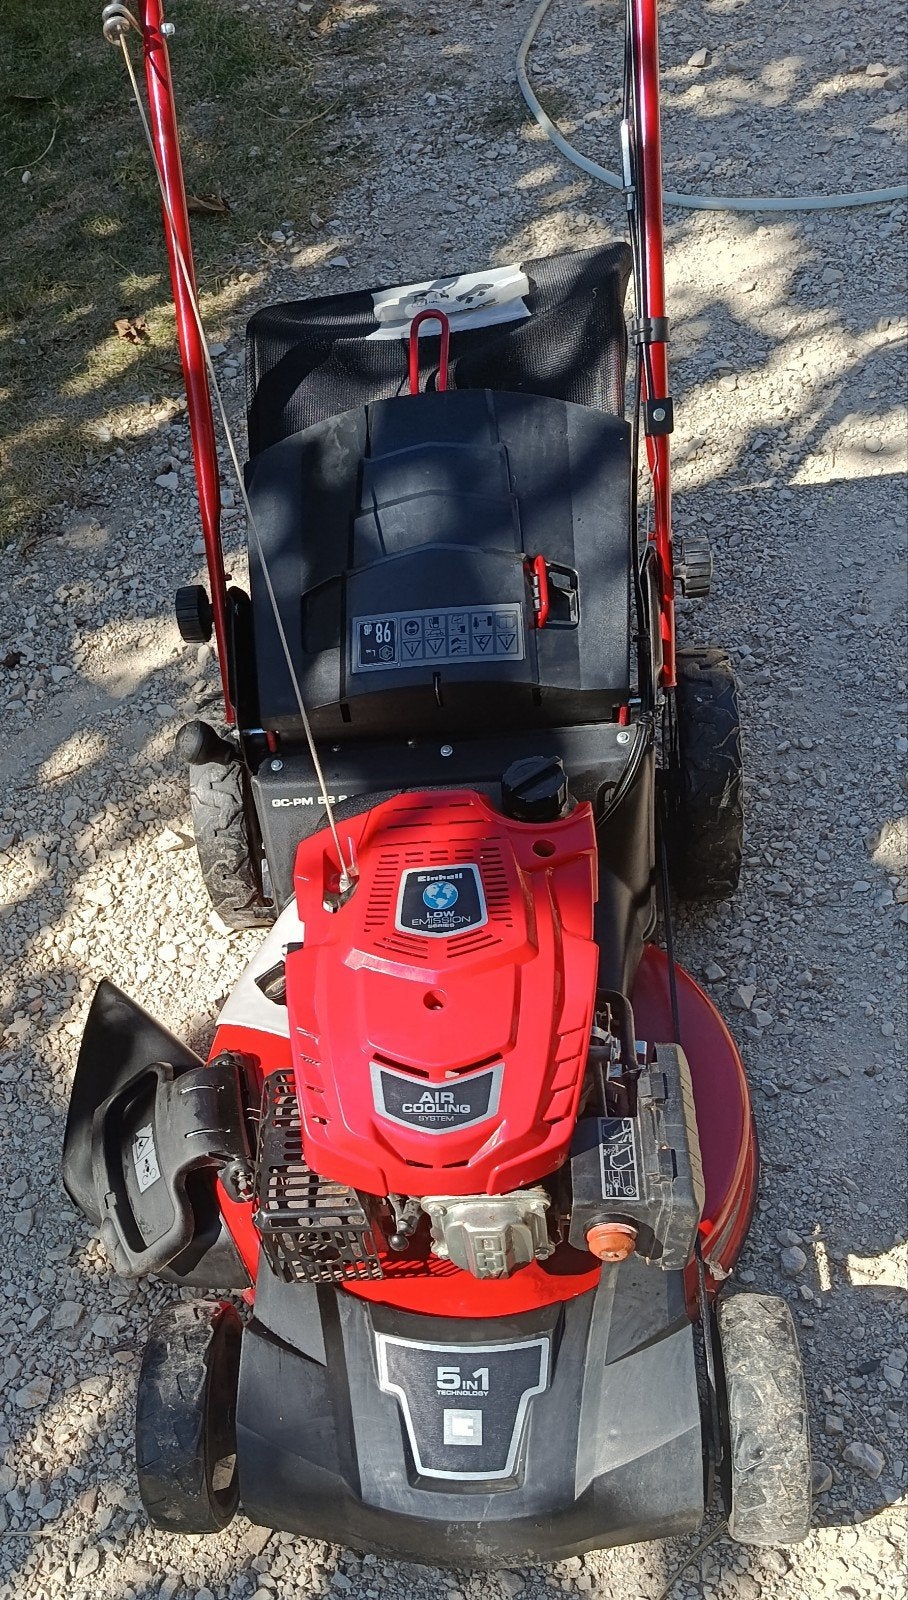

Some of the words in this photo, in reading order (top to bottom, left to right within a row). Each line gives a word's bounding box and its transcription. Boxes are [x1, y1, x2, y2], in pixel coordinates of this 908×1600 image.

[271, 797, 313, 807] GC-PM
[417, 873, 463, 882] Einhell
[426, 910, 455, 919] LOW
[411, 915, 471, 926] EMISSION
[418, 1091, 455, 1103] AIR
[402, 1103, 471, 1113] COOLING
